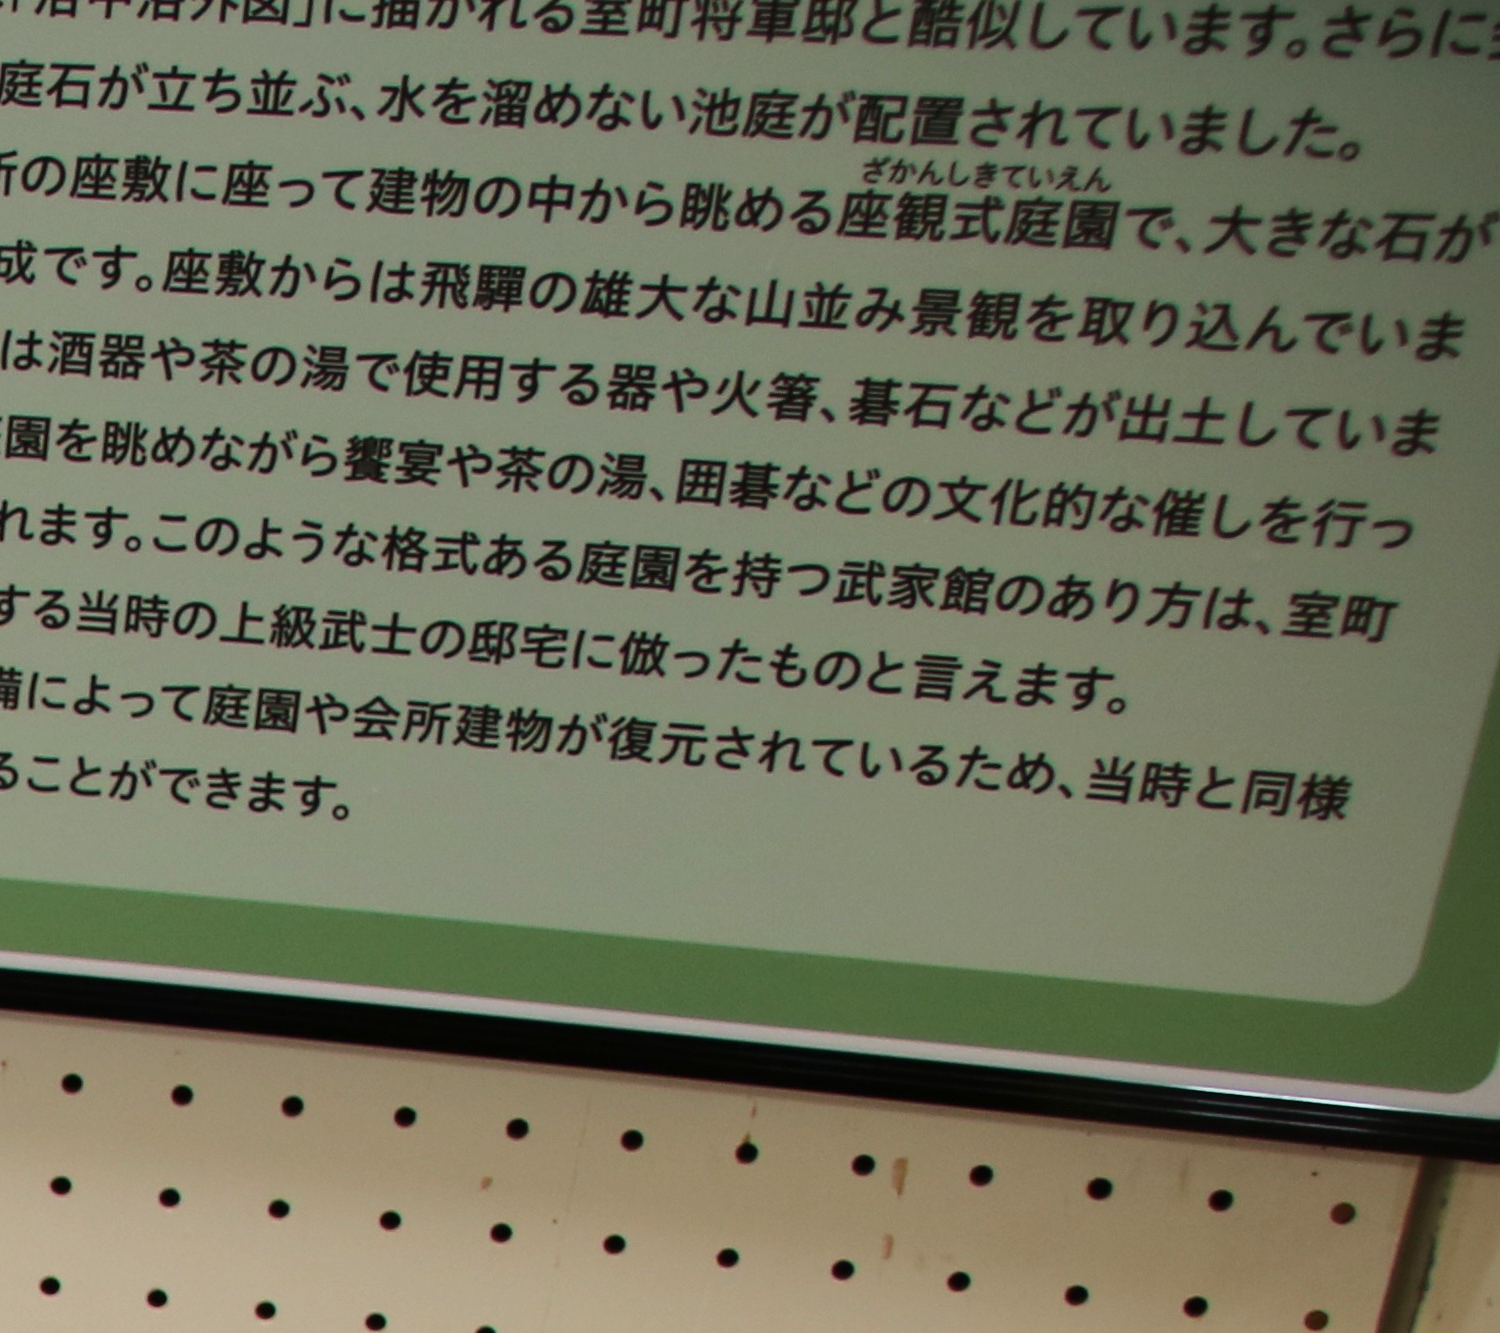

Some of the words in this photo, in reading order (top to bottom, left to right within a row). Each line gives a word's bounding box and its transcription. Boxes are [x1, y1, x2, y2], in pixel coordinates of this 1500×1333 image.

[861, 156, 1113, 195] ざかんしきていえん
